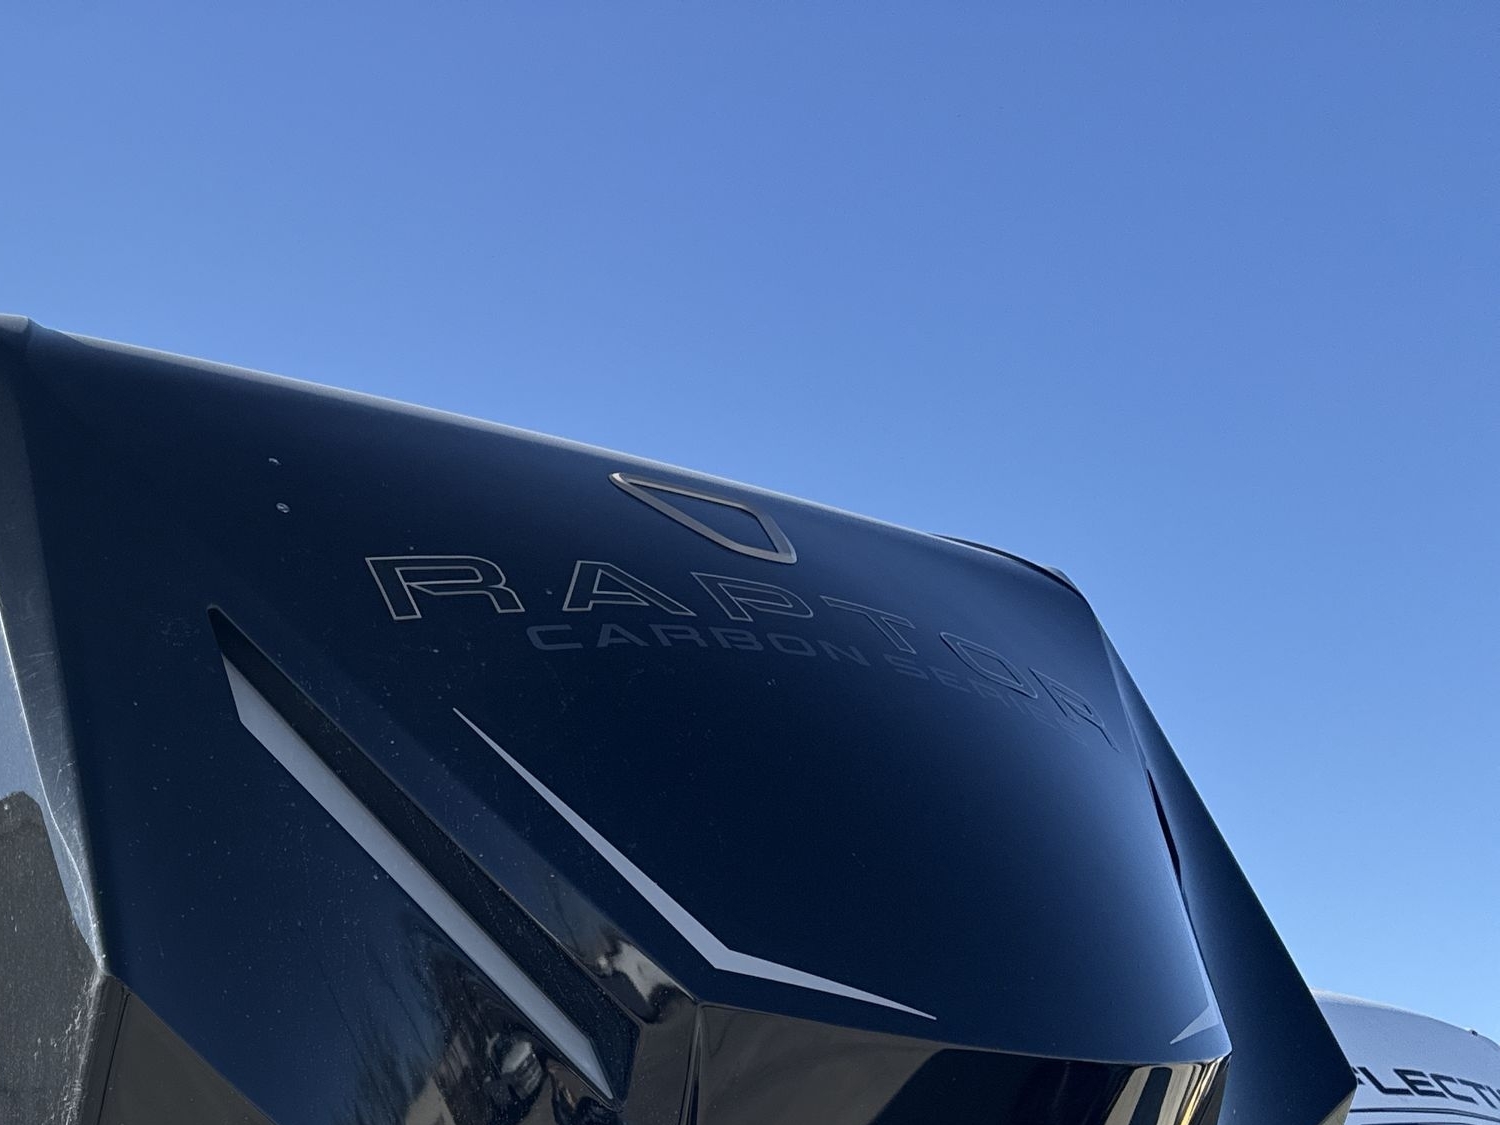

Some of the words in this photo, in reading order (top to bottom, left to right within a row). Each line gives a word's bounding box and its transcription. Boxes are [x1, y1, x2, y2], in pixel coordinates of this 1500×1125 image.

[365, 554, 1120, 753] RAPTOR
[526, 622, 871, 667] CARBON
[883, 653, 1087, 746] SERIES
